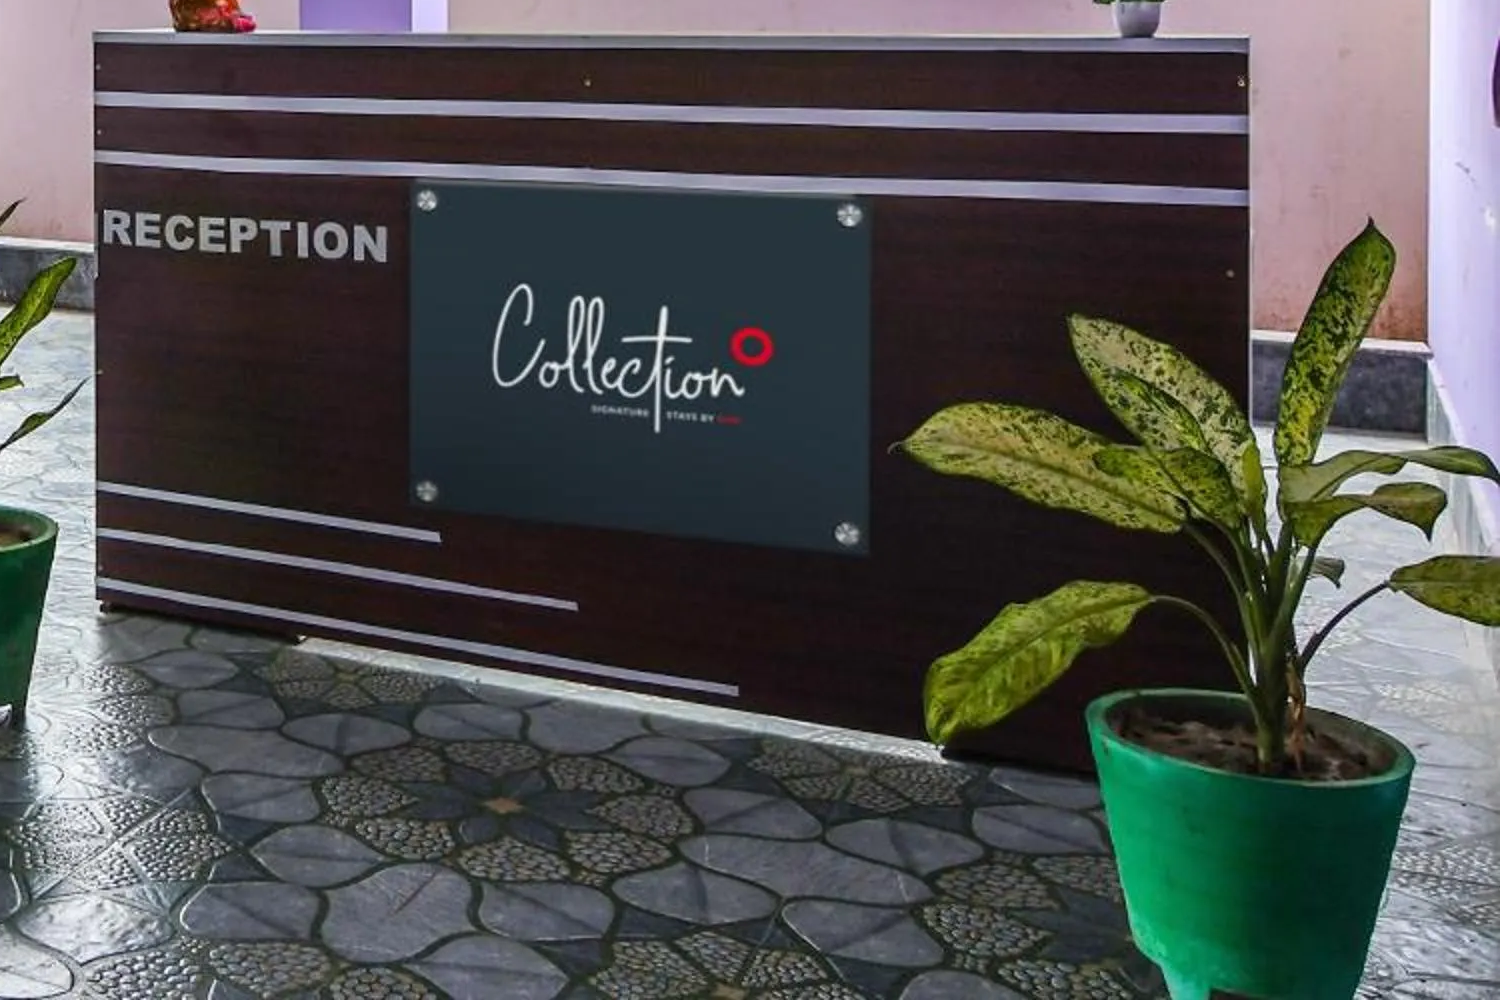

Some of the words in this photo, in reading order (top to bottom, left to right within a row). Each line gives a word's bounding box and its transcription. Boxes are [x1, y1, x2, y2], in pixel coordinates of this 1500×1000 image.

[102, 208, 389, 264] RECEPTION
[491, 283, 745, 433] Collection
[590, 404, 651, 418] SIGNATURE
[666, 410, 698, 422] STAYS
[700, 412, 715, 423] BY
